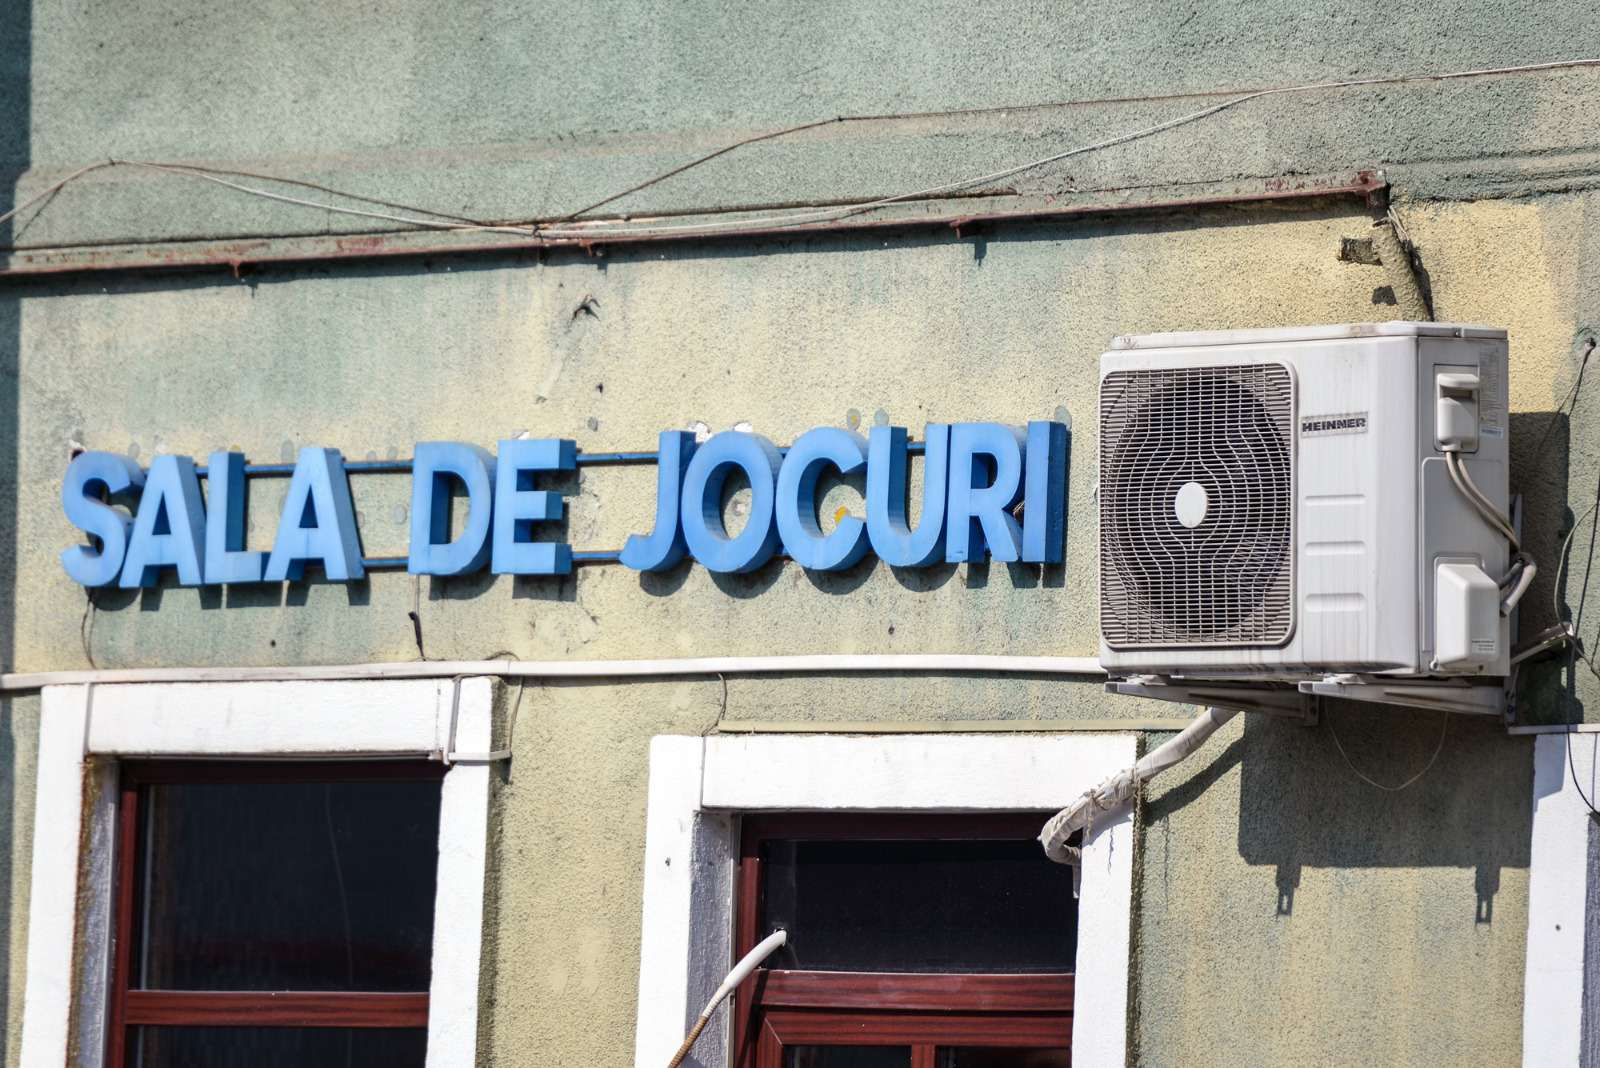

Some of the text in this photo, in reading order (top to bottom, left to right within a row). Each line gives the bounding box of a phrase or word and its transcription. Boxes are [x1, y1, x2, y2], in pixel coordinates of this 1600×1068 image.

[1302, 417, 1367, 432] HEINNER
[60, 421, 1067, 588] SALA DE JOCURI
